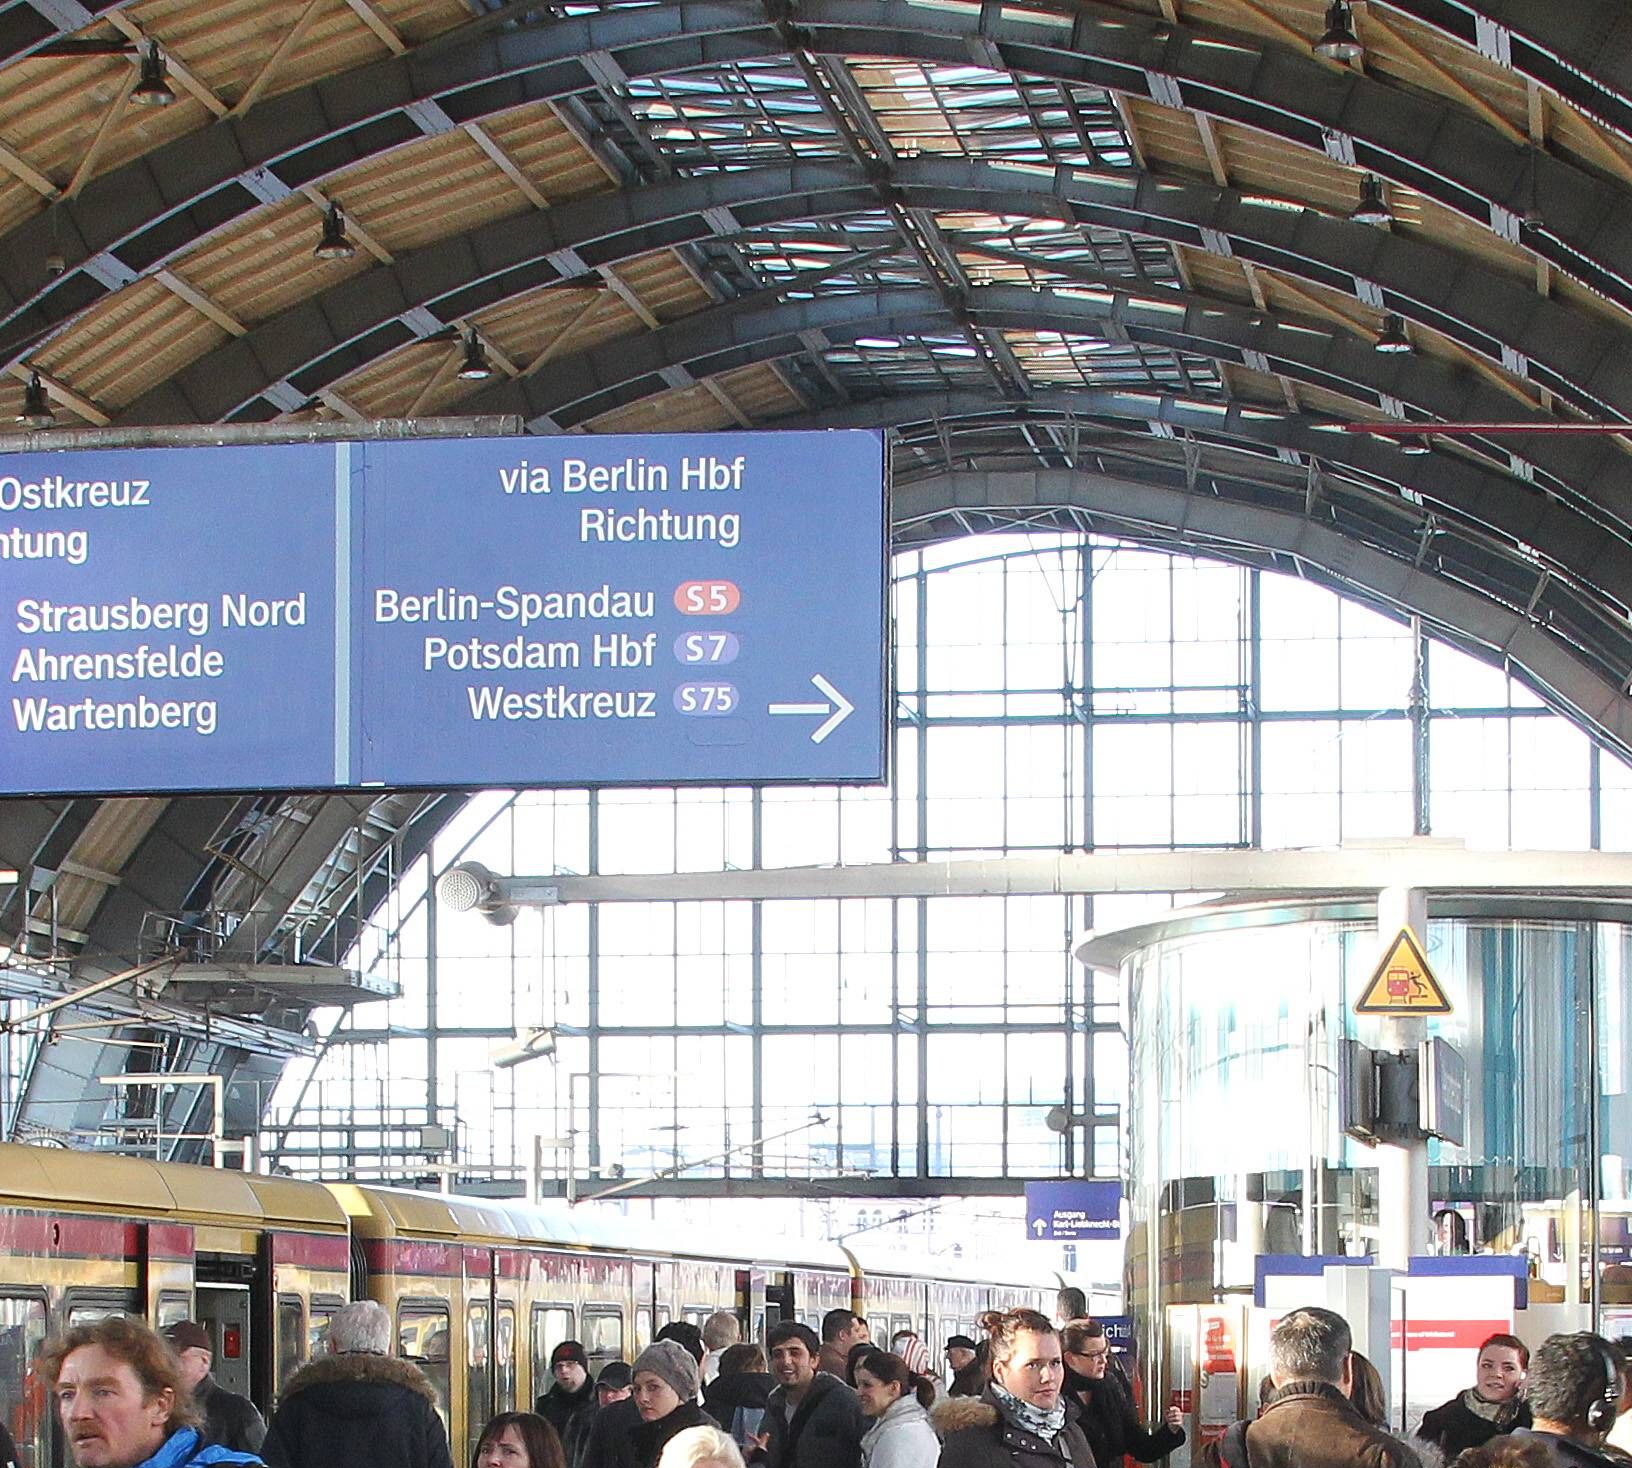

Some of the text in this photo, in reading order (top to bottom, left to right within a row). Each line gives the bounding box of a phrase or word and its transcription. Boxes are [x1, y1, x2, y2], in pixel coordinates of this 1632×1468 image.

[499, 457, 745, 493] via Berlin Hbf
[580, 508, 740, 547] Richtung
[17, 597, 208, 634] Strausberg
[222, 593, 306, 627] Nord
[375, 584, 654, 626] Berlin-Spandau
[12, 645, 224, 682] Ahrensfelde
[424, 636, 579, 670] Potsdam
[593, 633, 657, 667] Hbf
[12, 695, 217, 734] Wartenberg
[468, 686, 732, 719] Westkreuz S75
